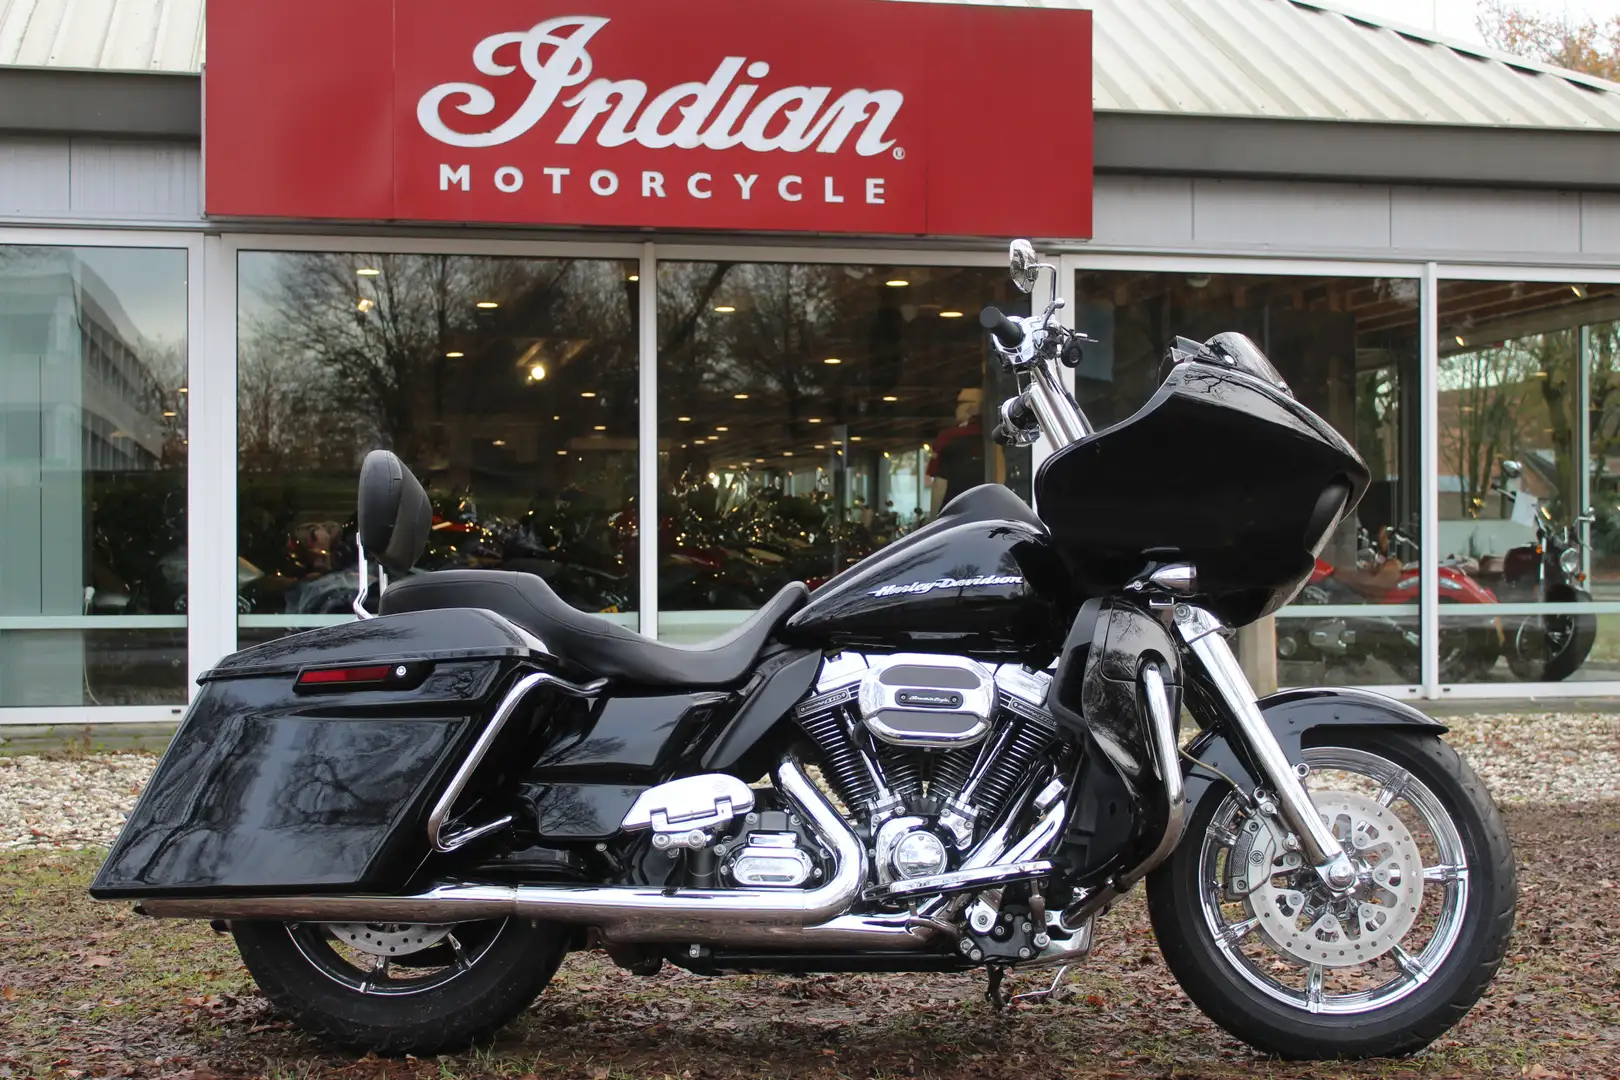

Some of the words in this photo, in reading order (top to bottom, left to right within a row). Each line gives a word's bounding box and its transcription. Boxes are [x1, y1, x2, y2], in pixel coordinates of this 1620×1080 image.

[417, 16, 904, 157] Indian
[439, 163, 885, 205] MOTORCYCLE
[867, 574, 1024, 597] Harley-Davidson
